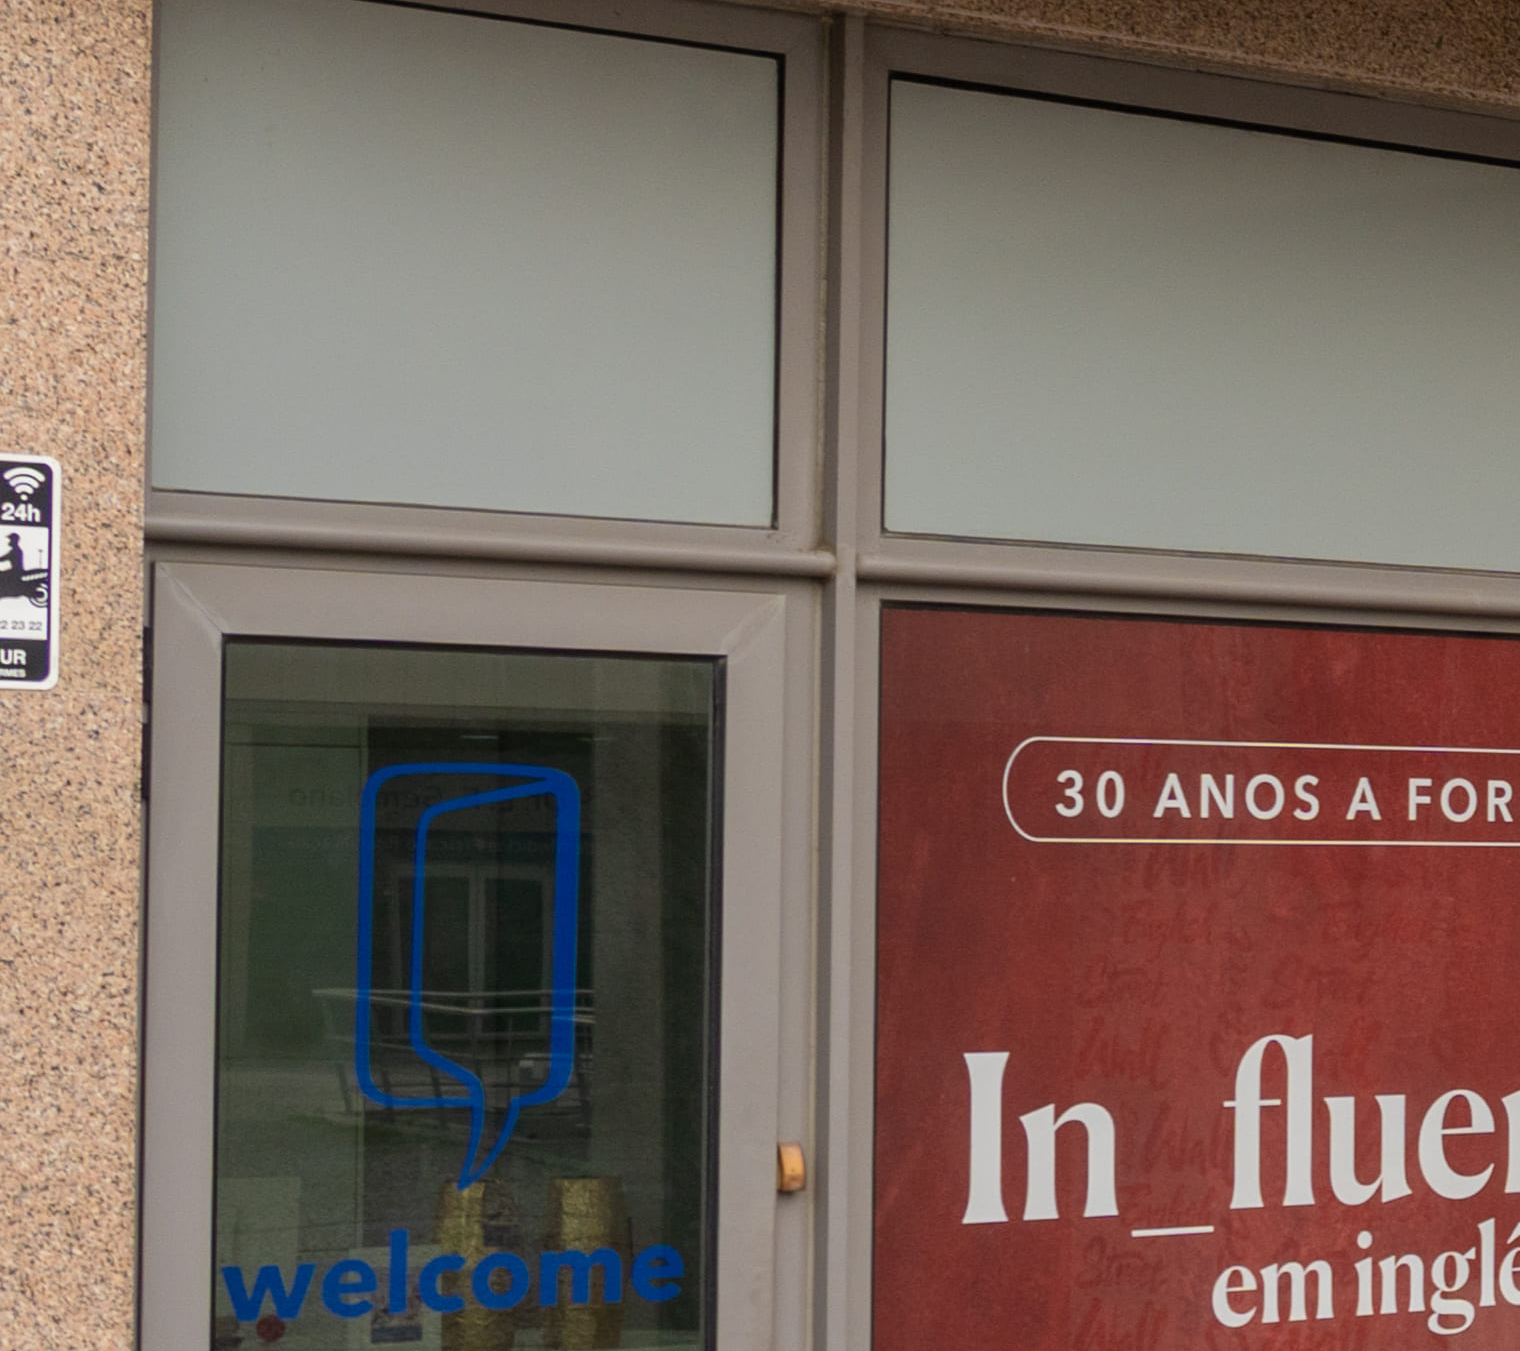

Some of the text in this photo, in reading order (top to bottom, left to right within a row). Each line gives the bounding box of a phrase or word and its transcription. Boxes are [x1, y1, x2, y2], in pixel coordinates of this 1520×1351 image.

[1055, 769, 1125, 819] 30
[1153, 772, 1321, 821] ANOS
[1346, 778, 1382, 822] A
[221, 1228, 685, 1323] welcome
[1212, 1259, 1334, 1329] em
